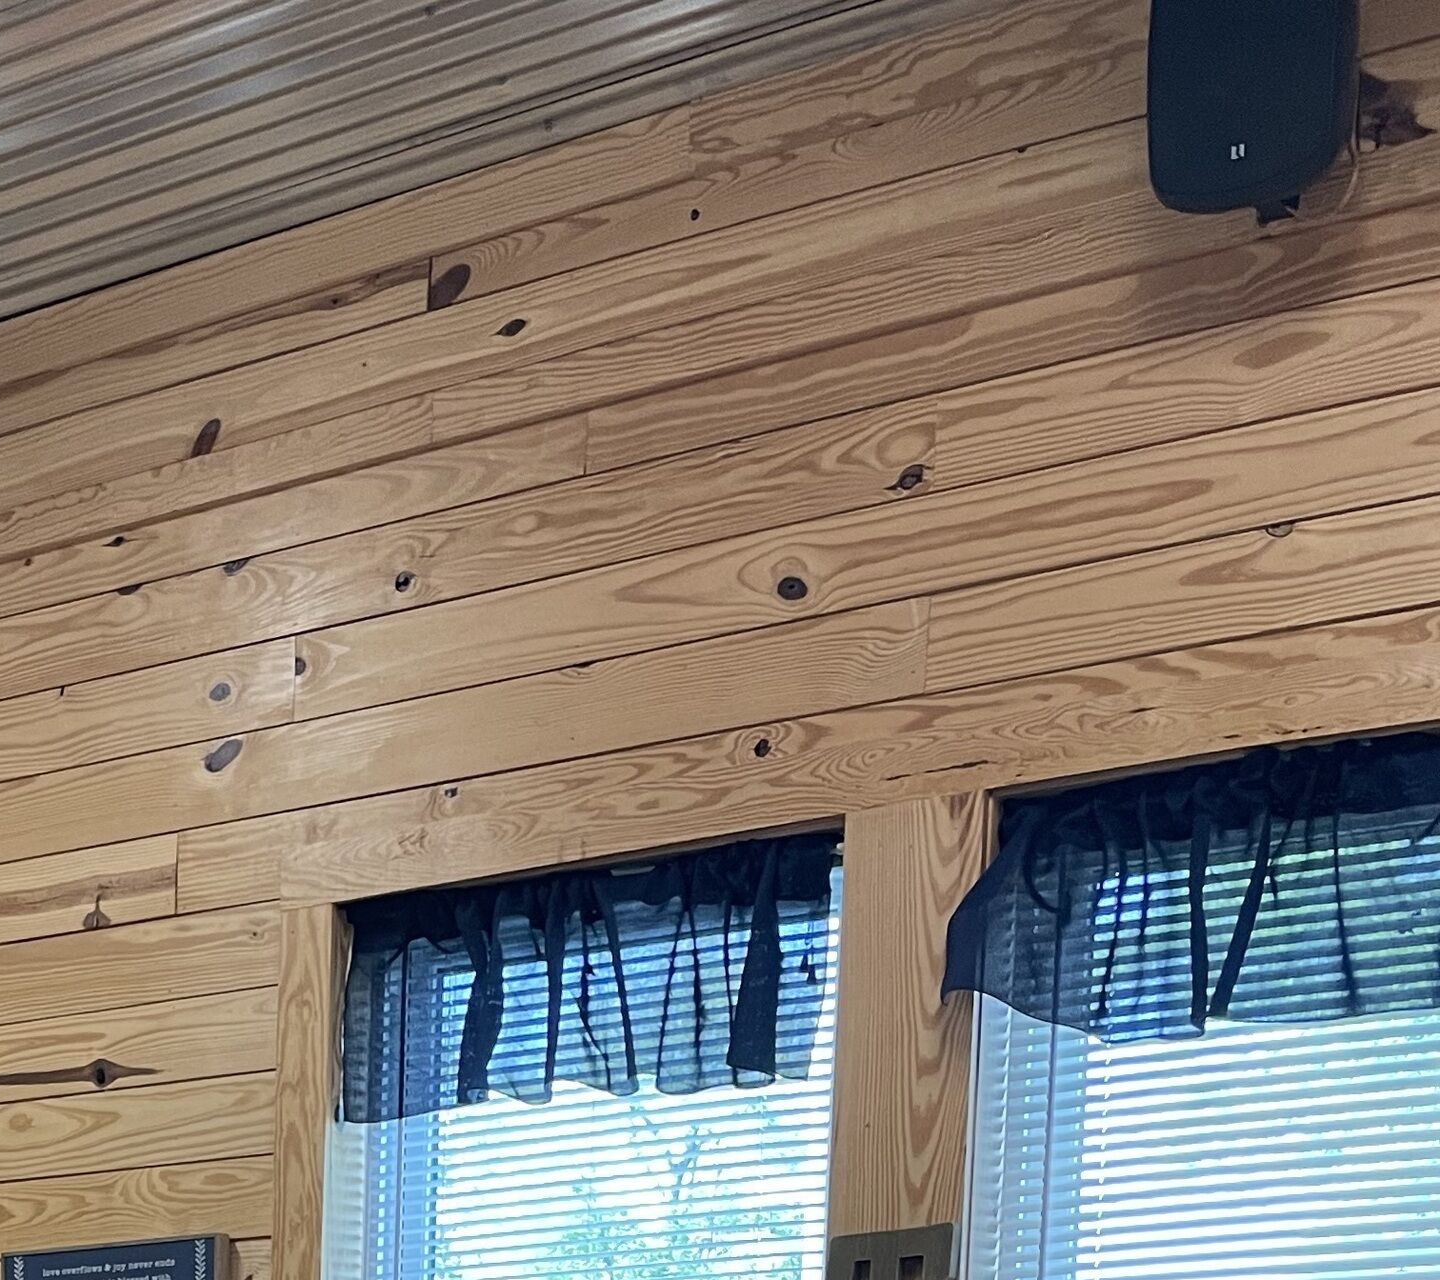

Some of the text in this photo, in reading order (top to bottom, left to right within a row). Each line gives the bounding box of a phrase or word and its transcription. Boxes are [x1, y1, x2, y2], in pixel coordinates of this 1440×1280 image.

[43, 1258, 176, 1278] love overflows & joy never ends
